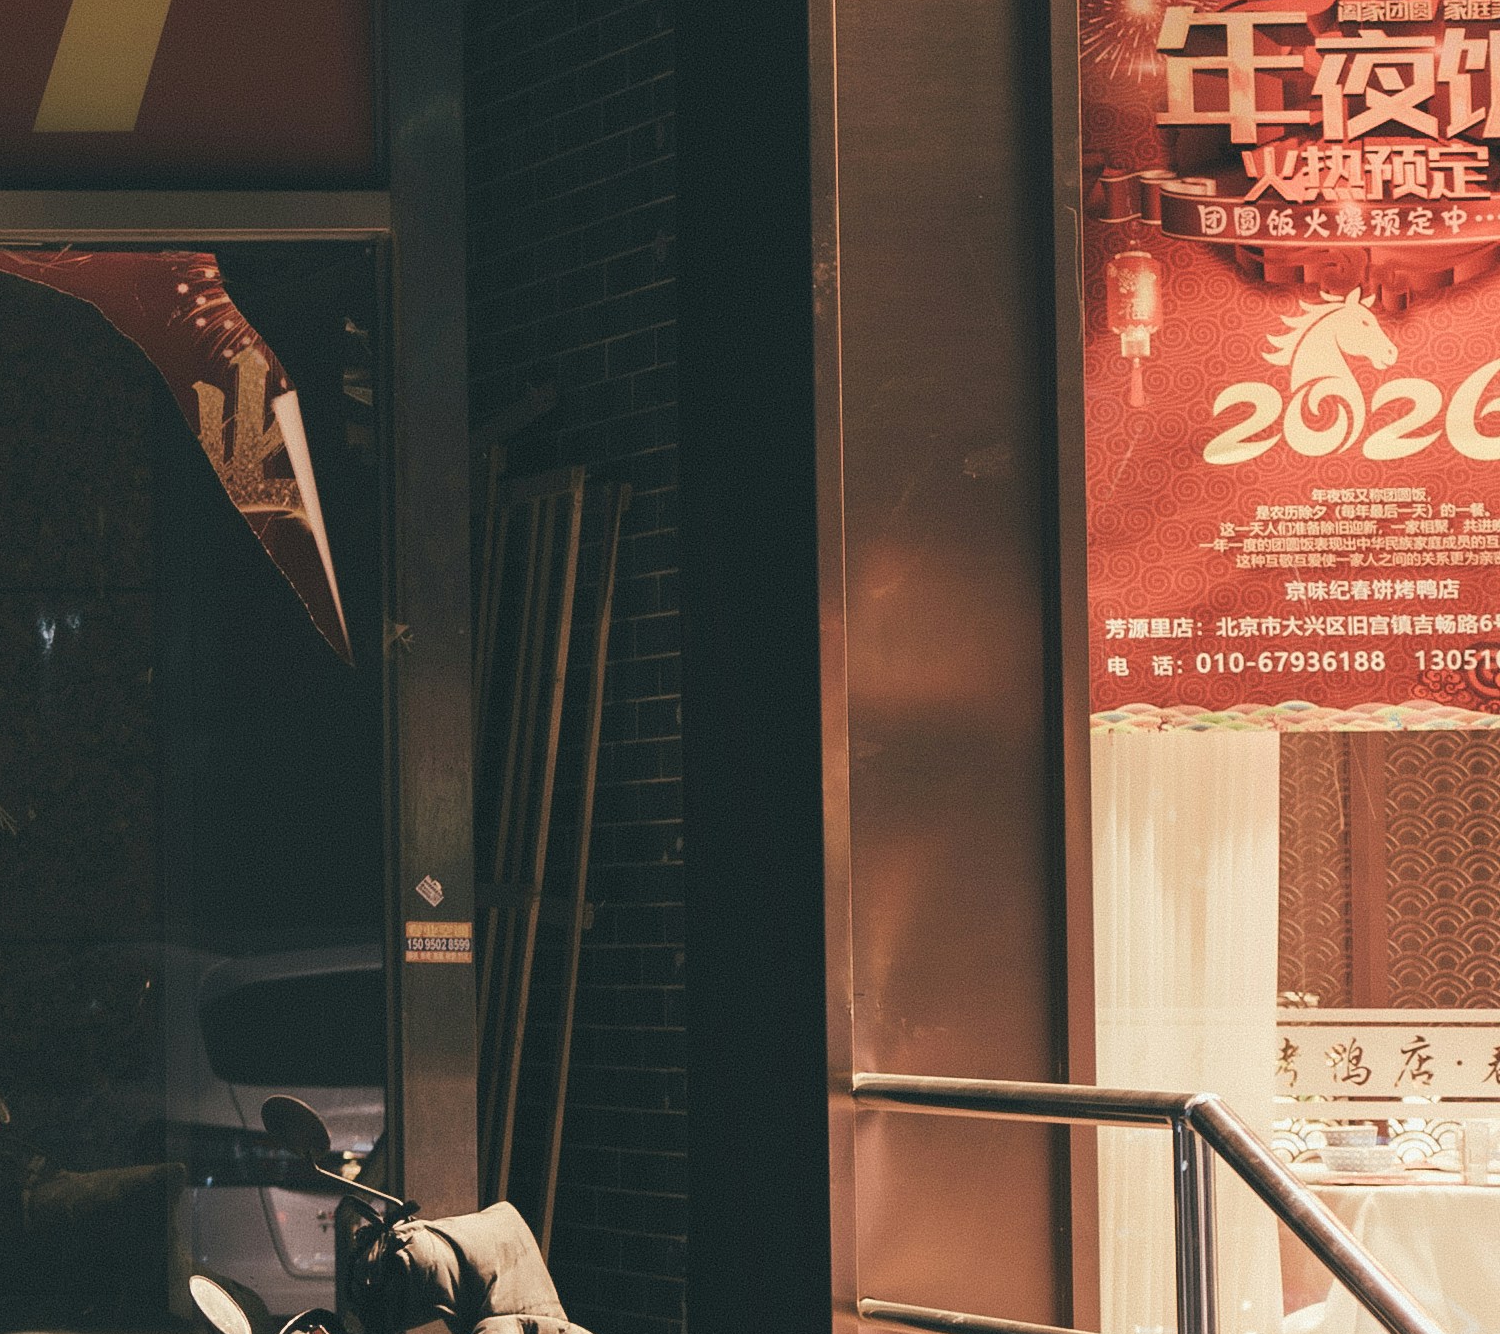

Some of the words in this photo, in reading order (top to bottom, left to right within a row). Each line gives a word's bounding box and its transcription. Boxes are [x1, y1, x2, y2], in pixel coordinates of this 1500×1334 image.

[1242, 144, 1491, 203] 火热预定
[1284, 578, 1461, 602] 京味纪春饼烤鸭店
[1195, 649, 1386, 675] 010-67936188
